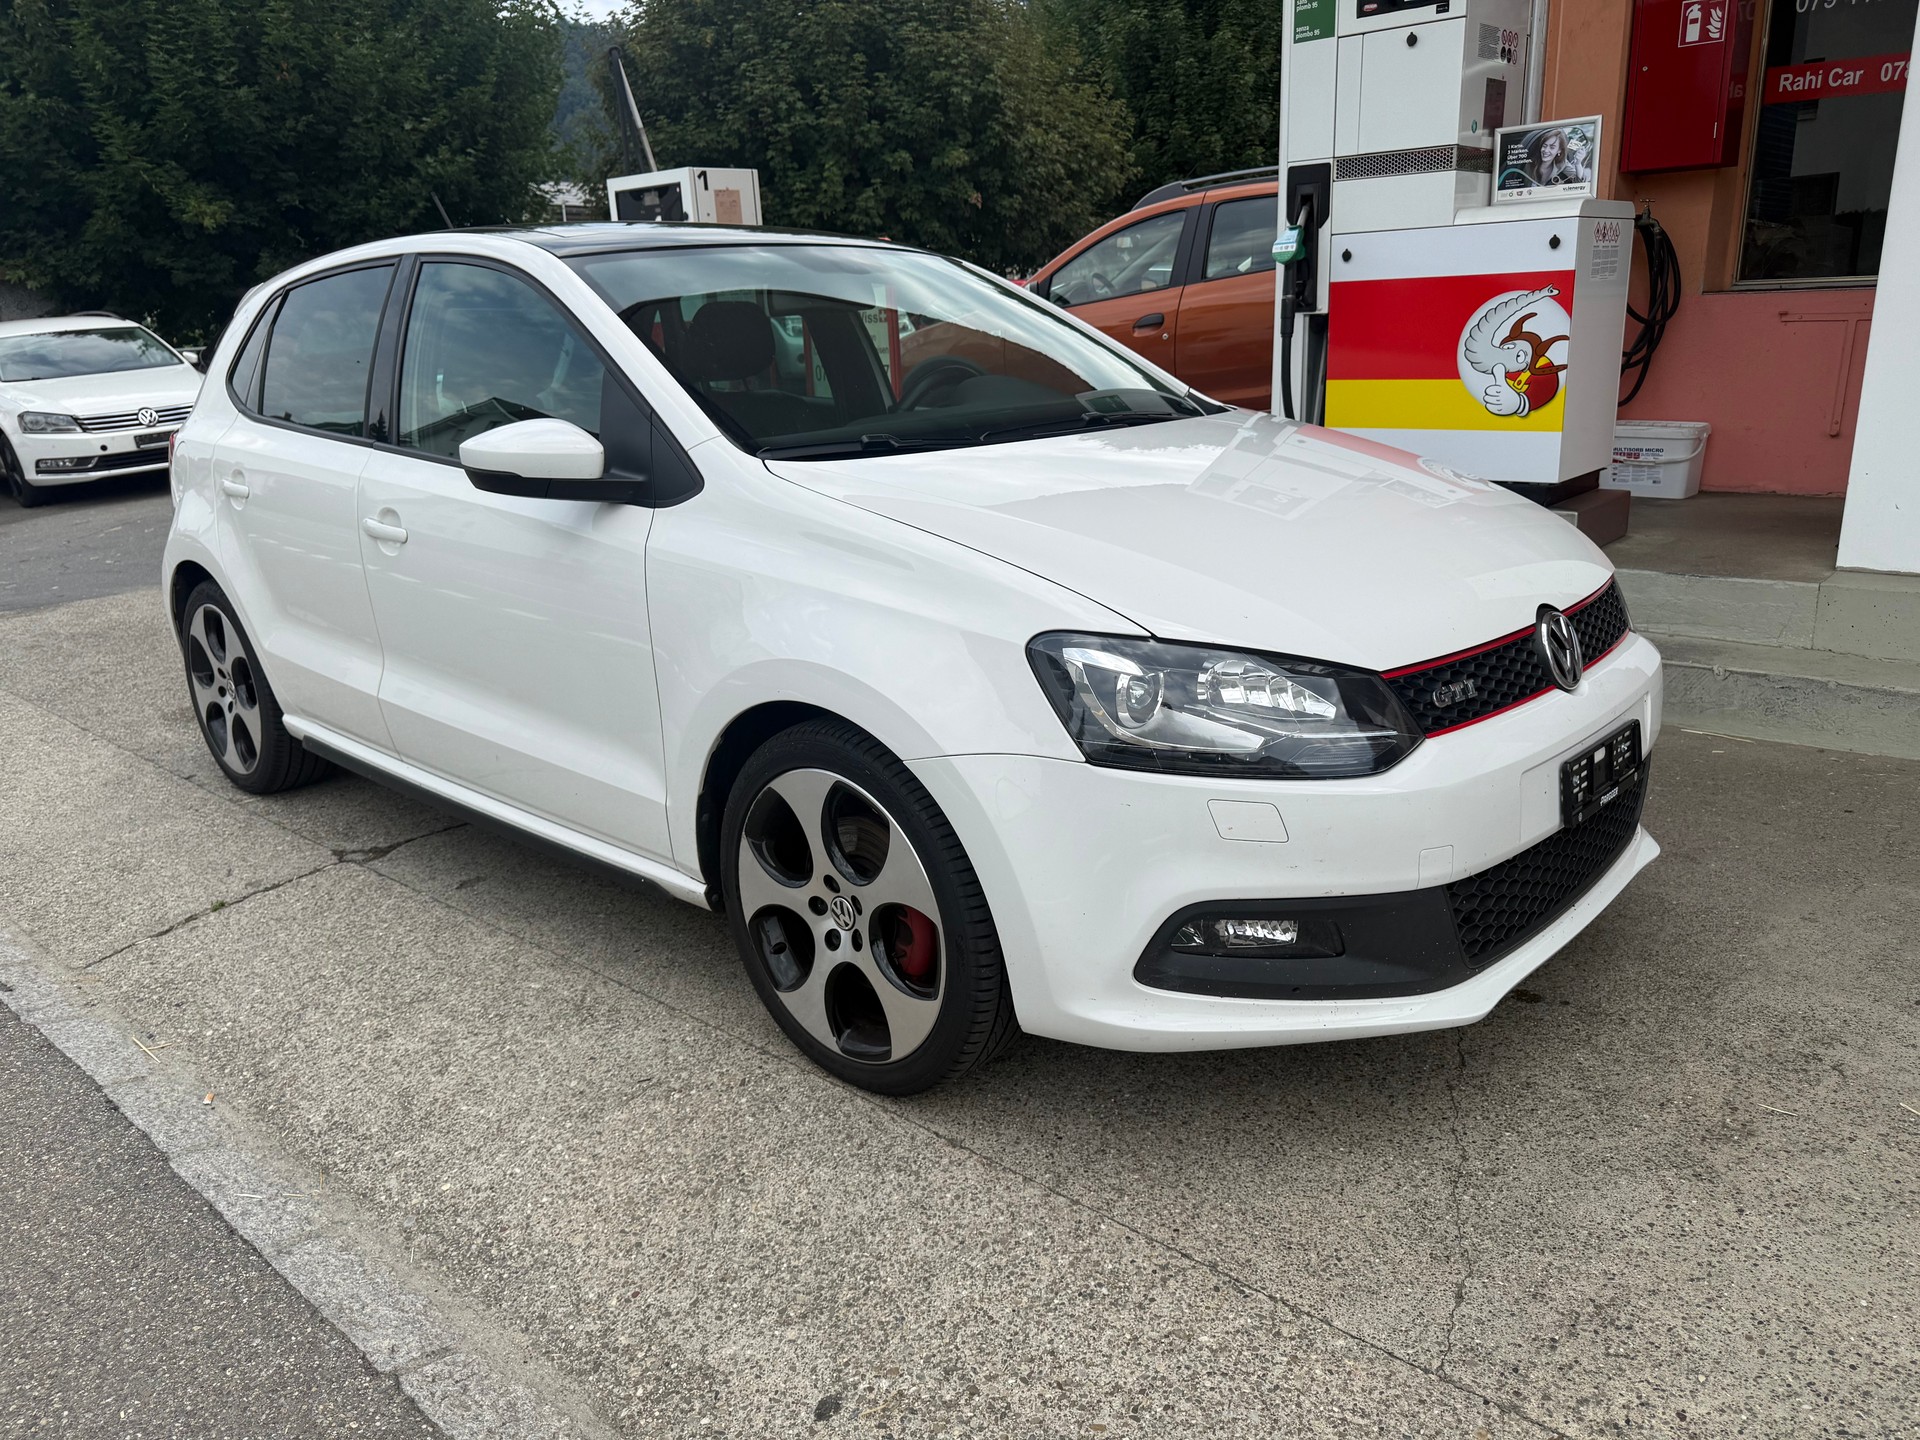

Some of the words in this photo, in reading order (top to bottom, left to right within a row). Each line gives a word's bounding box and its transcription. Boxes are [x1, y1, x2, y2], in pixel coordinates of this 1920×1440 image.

[1296, 3, 1312, 12] plomb
[1312, 1, 1319, 9] 95
[1295, 25, 1310, 33] senza
[1295, 31, 1314, 41] plombo
[1313, 28, 1321, 36] 95
[1778, 69, 1823, 92] Rahi
[1828, 68, 1865, 88] Car
[697, 170, 709, 191] 1
[1432, 679, 1478, 708] GTI
